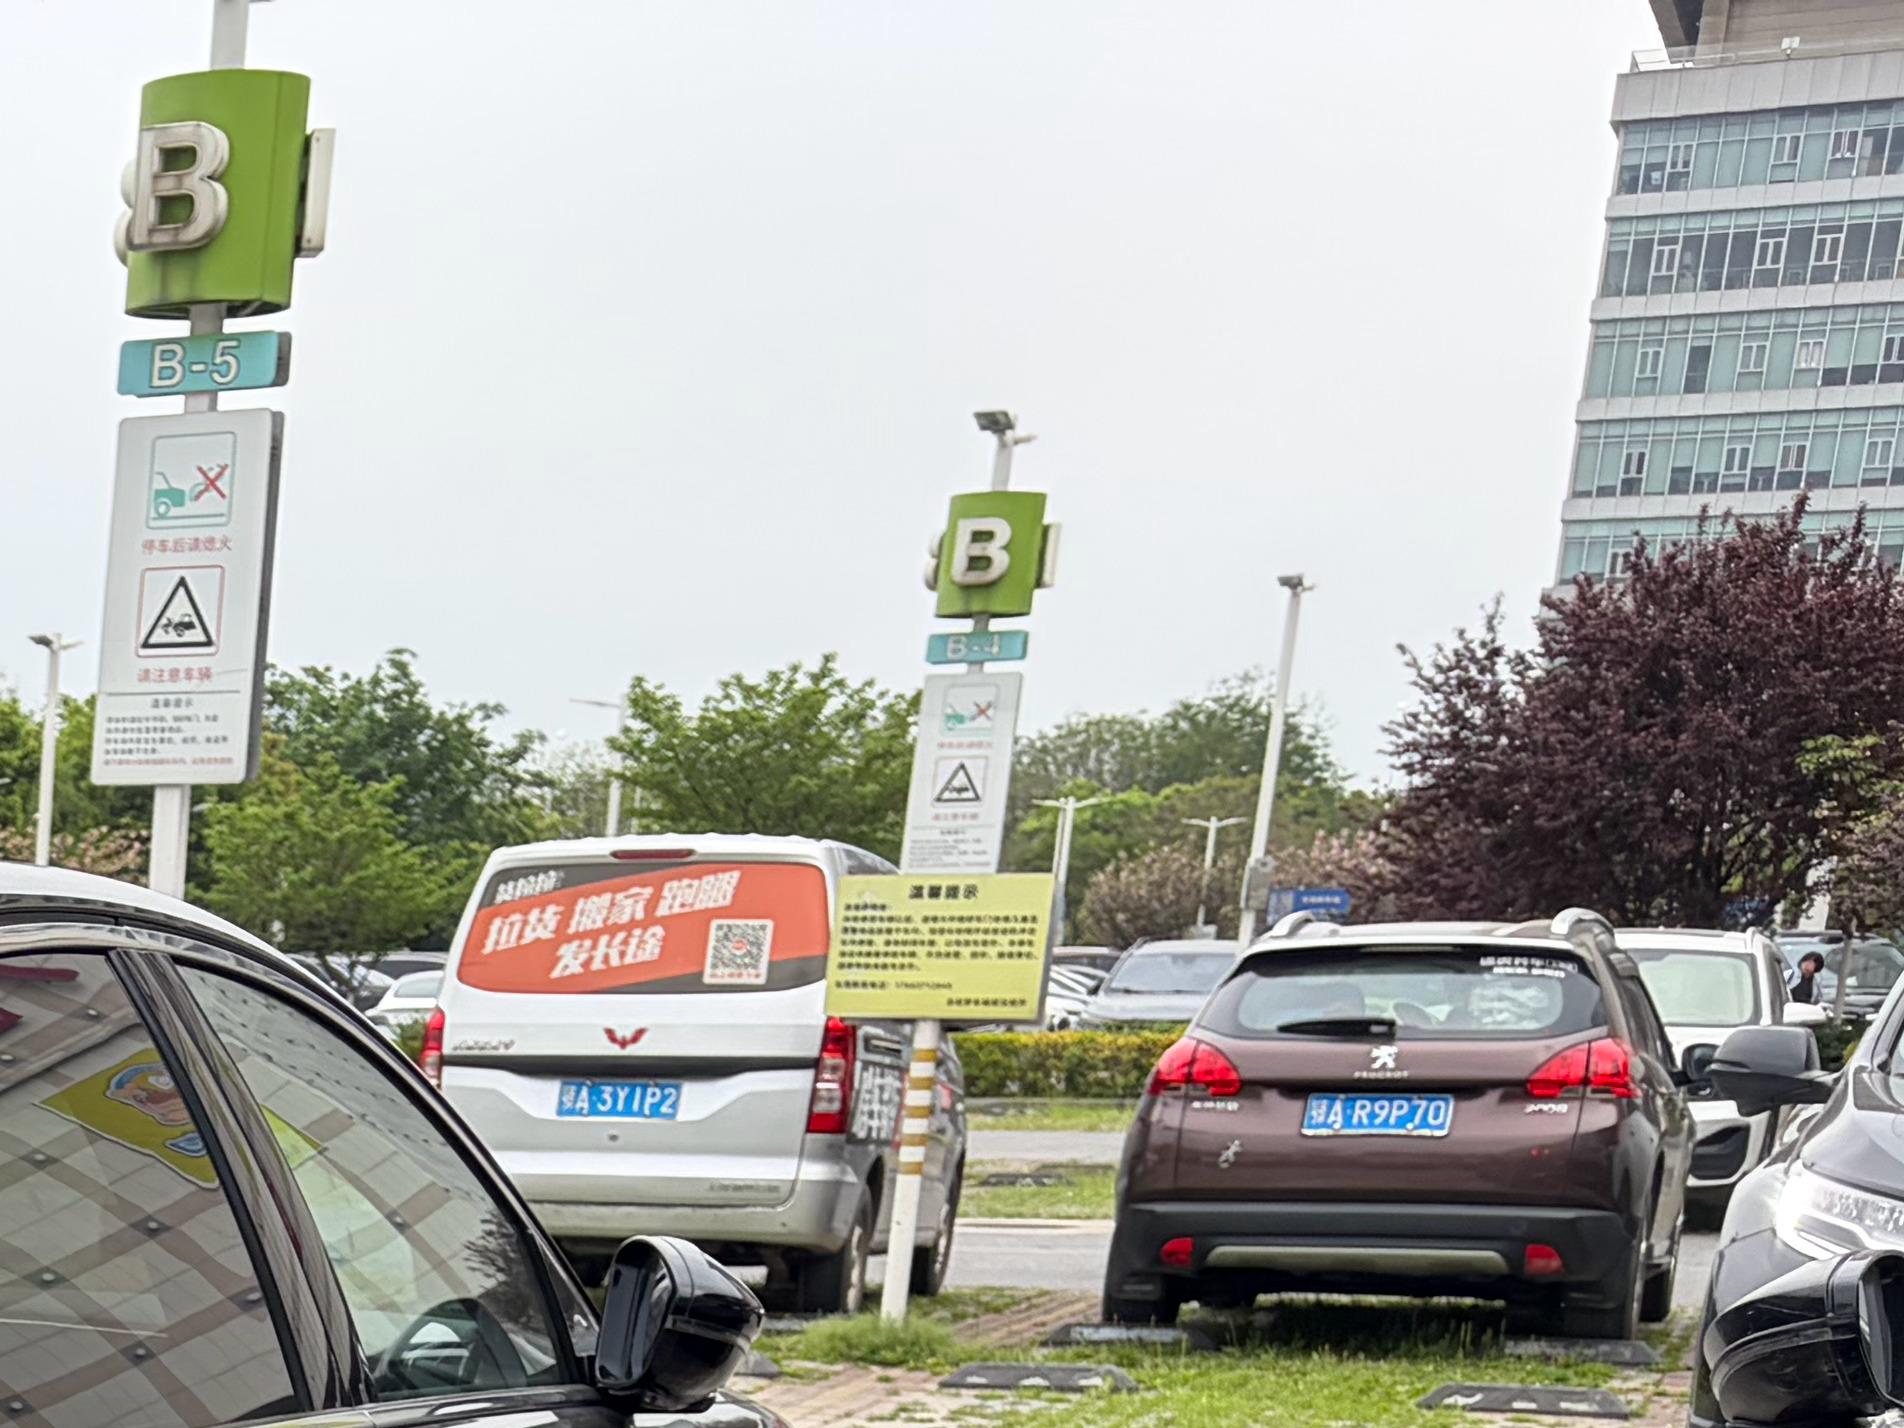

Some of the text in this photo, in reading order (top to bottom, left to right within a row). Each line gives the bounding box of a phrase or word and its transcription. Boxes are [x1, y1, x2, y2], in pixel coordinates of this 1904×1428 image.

[128, 121, 230, 252] B
[149, 340, 240, 387] B-5
[951, 517, 1012, 585] B
[482, 903, 565, 955] 拉货
[567, 886, 655, 935] 搬家
[548, 924, 666, 979] 发长途
